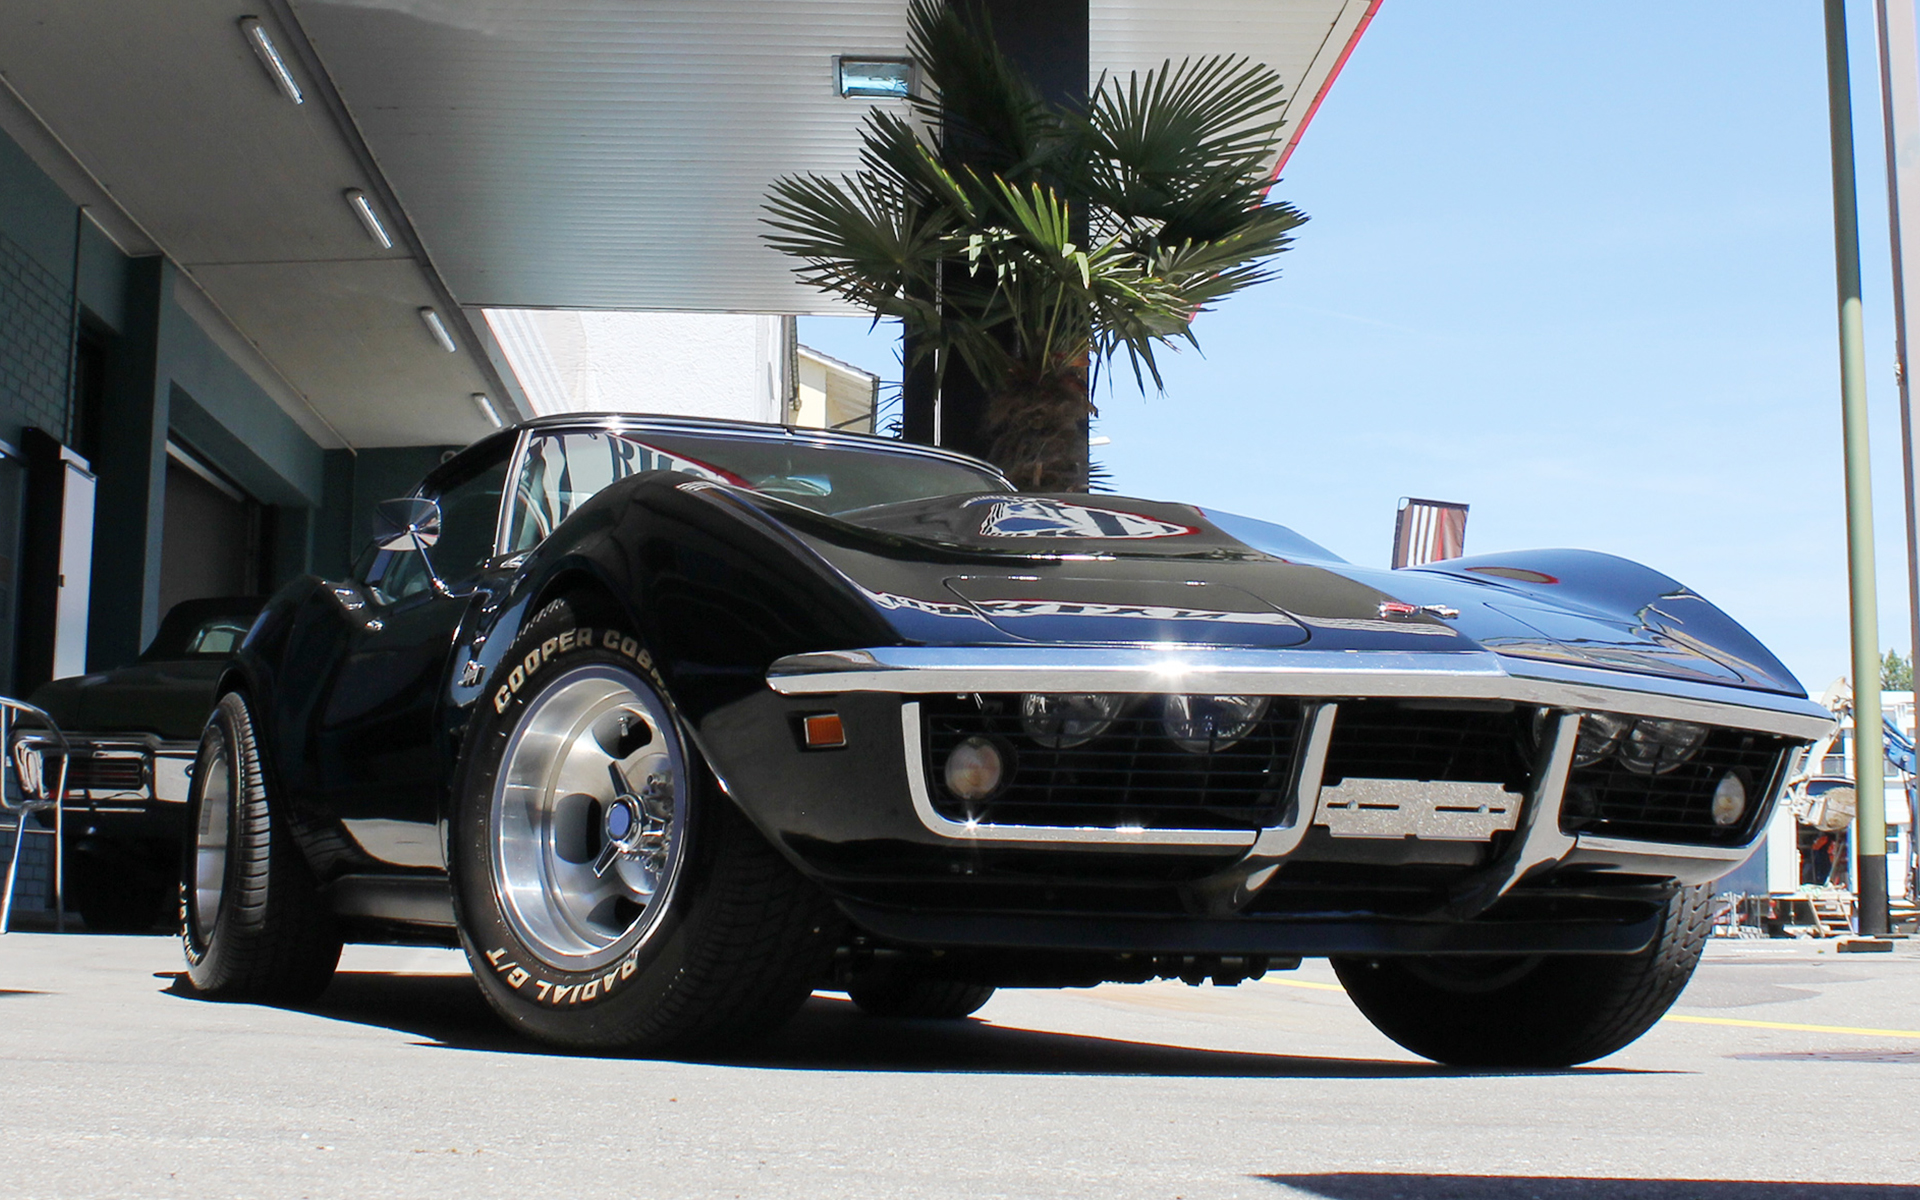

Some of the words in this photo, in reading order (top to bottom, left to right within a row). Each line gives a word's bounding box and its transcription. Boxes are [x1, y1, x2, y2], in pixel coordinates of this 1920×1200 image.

[494, 628, 592, 713] COOPER
[486, 947, 531, 989] G/T
[535, 950, 639, 1004] RADIAL
